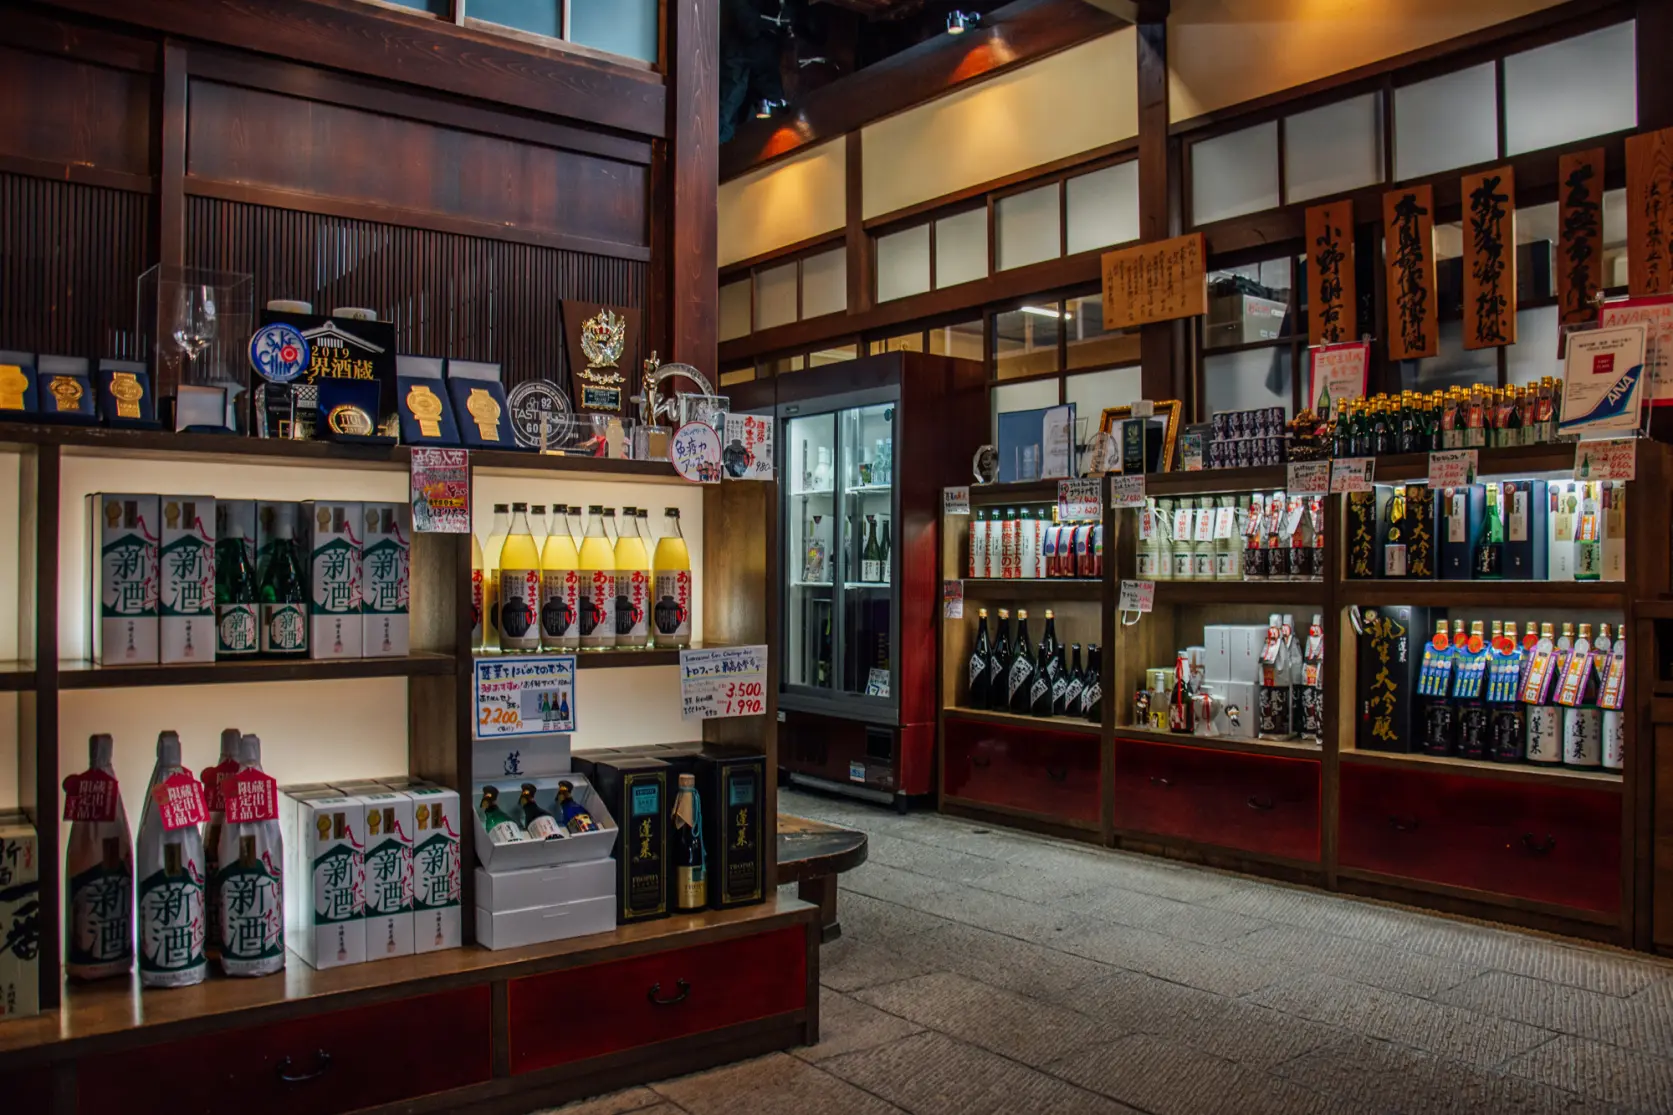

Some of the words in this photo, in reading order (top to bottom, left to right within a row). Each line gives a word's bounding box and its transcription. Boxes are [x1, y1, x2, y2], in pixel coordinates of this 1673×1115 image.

[266, 331, 300, 353] SAKE
[311, 347, 350, 359] 2019
[304, 358, 375, 380] 界酒蔵
[1607, 376, 1635, 407] ANA
[541, 398, 552, 408] 92
[526, 424, 553, 433] GOD
[675, 436, 707, 460] 免疫力
[745, 416, 756, 467] あまざけ
[427, 508, 467, 521] しぼりたて
[112, 546, 147, 613] 新酒
[170, 546, 204, 613] 新酒
[322, 546, 353, 612] 新酒
[370, 546, 402, 612] 新酒
[525, 571, 538, 625] あまざけ
[565, 571, 578, 625] あまざけ
[593, 571, 608, 625] あまざけ
[631, 571, 645, 624] あまざけ
[676, 571, 689, 624] あまざけ
[230, 612, 248, 650] 新酒
[280, 612, 298, 650] 新酒
[168, 787, 188, 826] 限定品
[180, 784, 199, 823] 蔵出し
[238, 781, 253, 820] 限定品
[252, 781, 266, 819] 蔵出し
[639, 816, 653, 859] 蓬莱
[736, 807, 749, 847] 蓬莱
[325, 854, 362, 917] 新酒
[373, 848, 404, 911] 新酒
[421, 843, 450, 904] 新酒
[89, 875, 128, 956] 新酒
[152, 881, 194, 964] 新酒
[229, 876, 272, 955] 新酒
